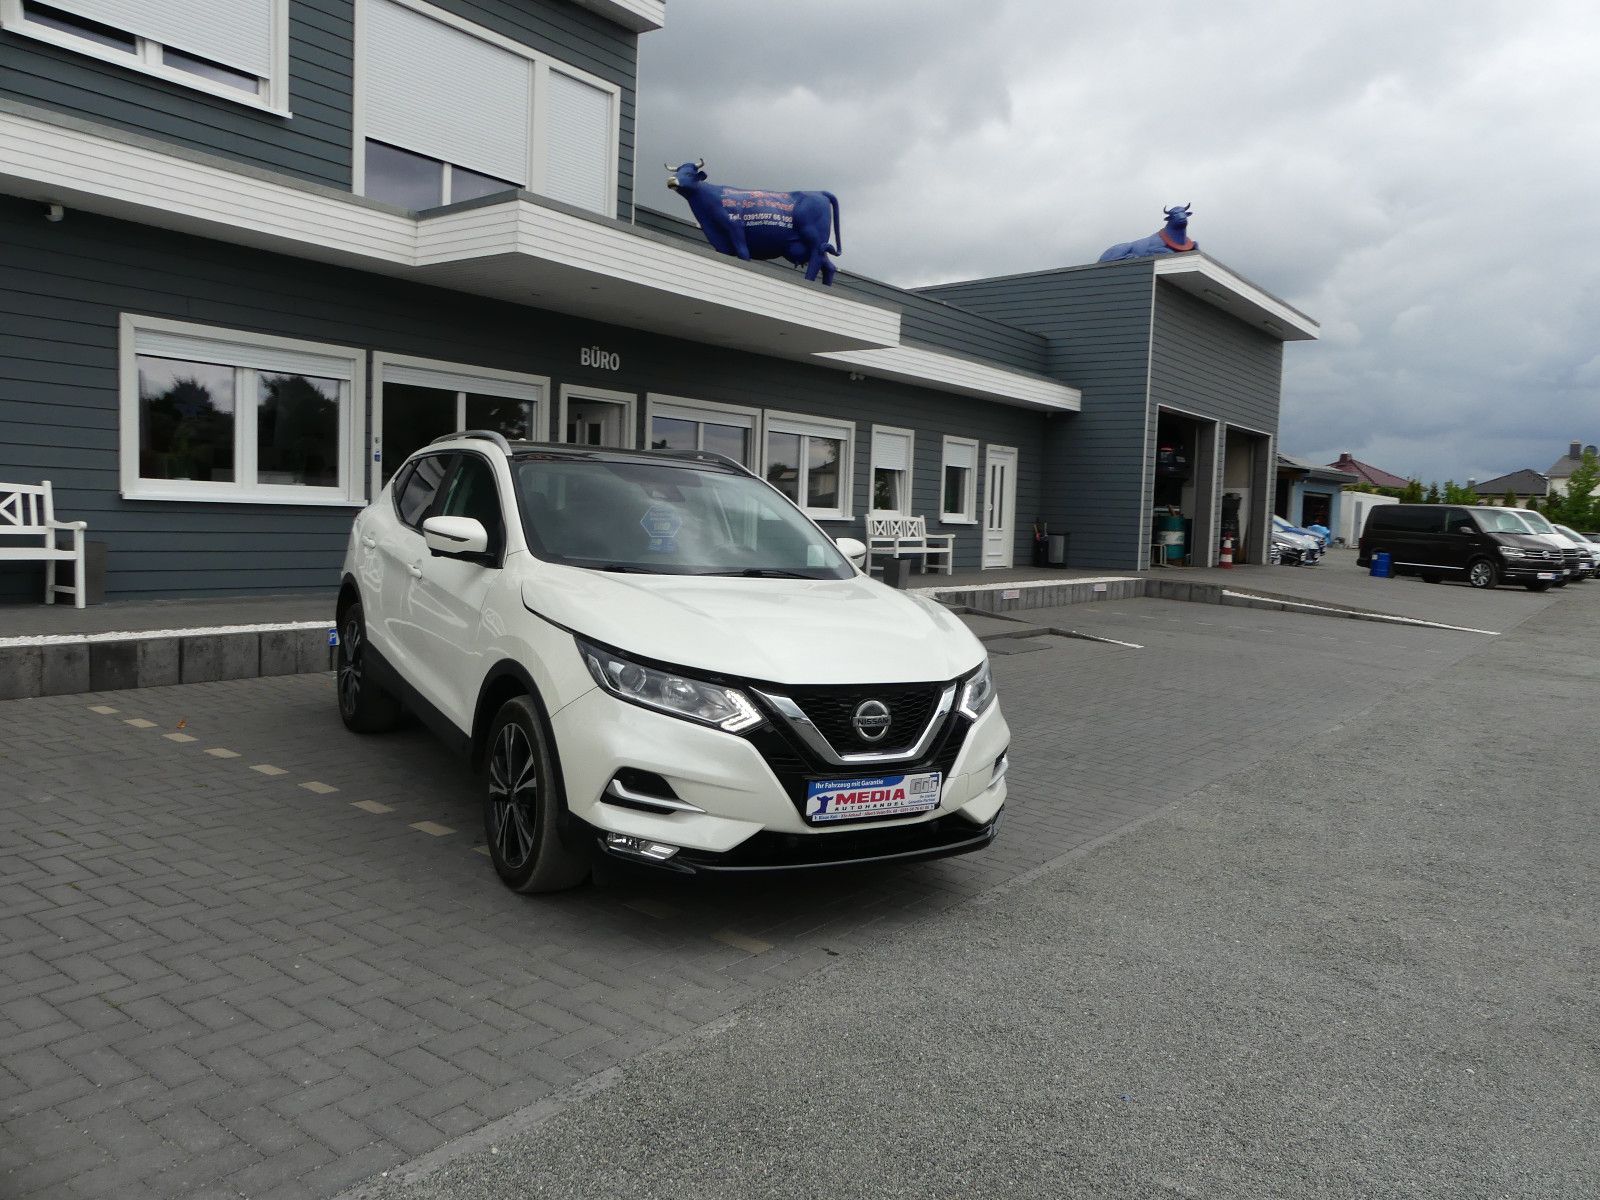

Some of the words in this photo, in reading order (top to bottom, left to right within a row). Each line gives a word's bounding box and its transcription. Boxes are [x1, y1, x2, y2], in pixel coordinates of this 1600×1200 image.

[728, 213, 741, 221] Tel.
[580, 345, 620, 371] BÜRO
[857, 717, 889, 726] NISSAN
[824, 781, 851, 790] Fahrzeug
[861, 779, 884, 787] Garantie
[835, 788, 906, 806] MEDIA
[834, 801, 906, 811] AUTOHANDEL
